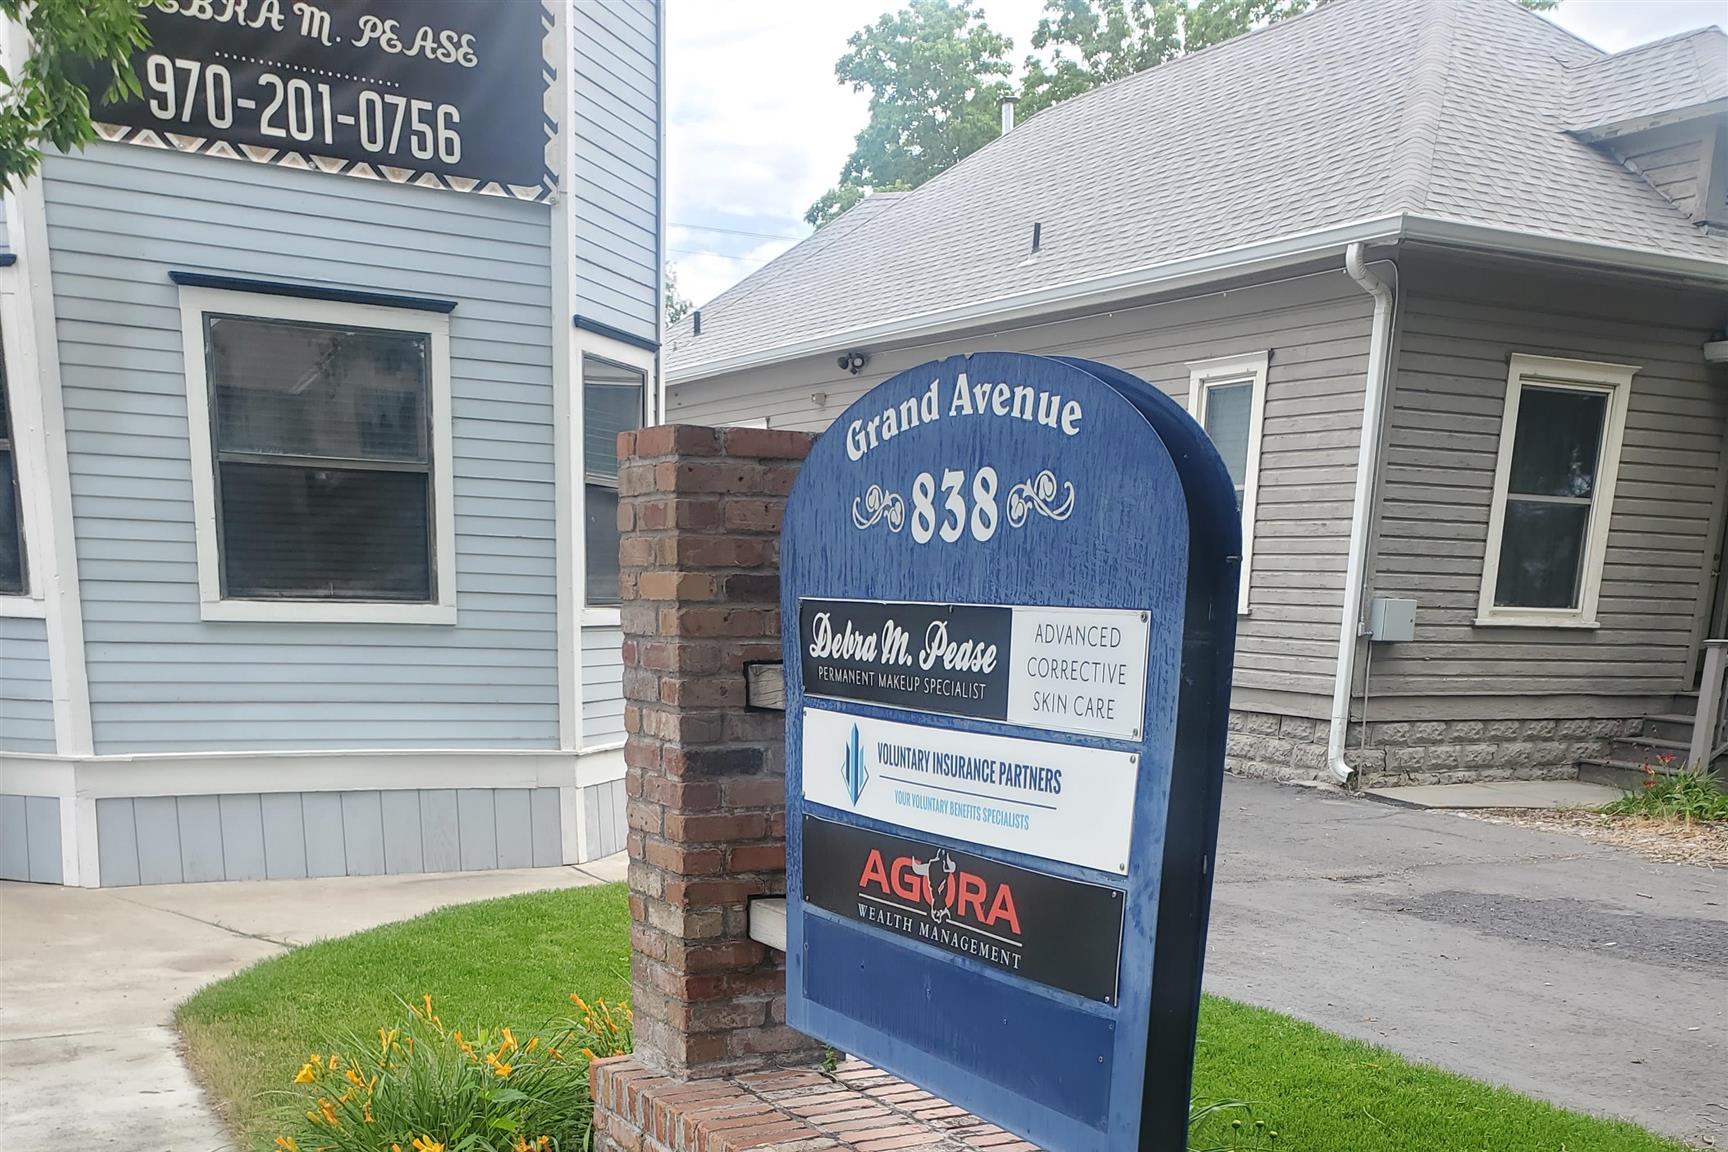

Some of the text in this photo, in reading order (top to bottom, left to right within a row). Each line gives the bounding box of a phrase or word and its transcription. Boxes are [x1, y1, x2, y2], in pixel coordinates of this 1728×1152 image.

[138, 0, 478, 68] BRA M. PEASE
[147, 54, 461, 165] 970-201-0756
[846, 373, 1083, 462] Grand Avenue
[911, 466, 999, 545] 838
[809, 612, 997, 674] Debra M. Pease
[1035, 624, 1121, 648] ADVANCED
[818, 666, 987, 700] PERMANENT MAKEUP SPECIALIST
[1027, 656, 1127, 685] CORRECTIVE
[1033, 691, 1115, 720] SKIN CARE
[877, 742, 1062, 795] VOLUNTARY INSURANCE PARTNERS
[894, 789, 1030, 831] YOUR VOLUNTARY BENEFITS SPECIALISTS
[857, 903, 1022, 970] WEALTH MANAGEMENT
